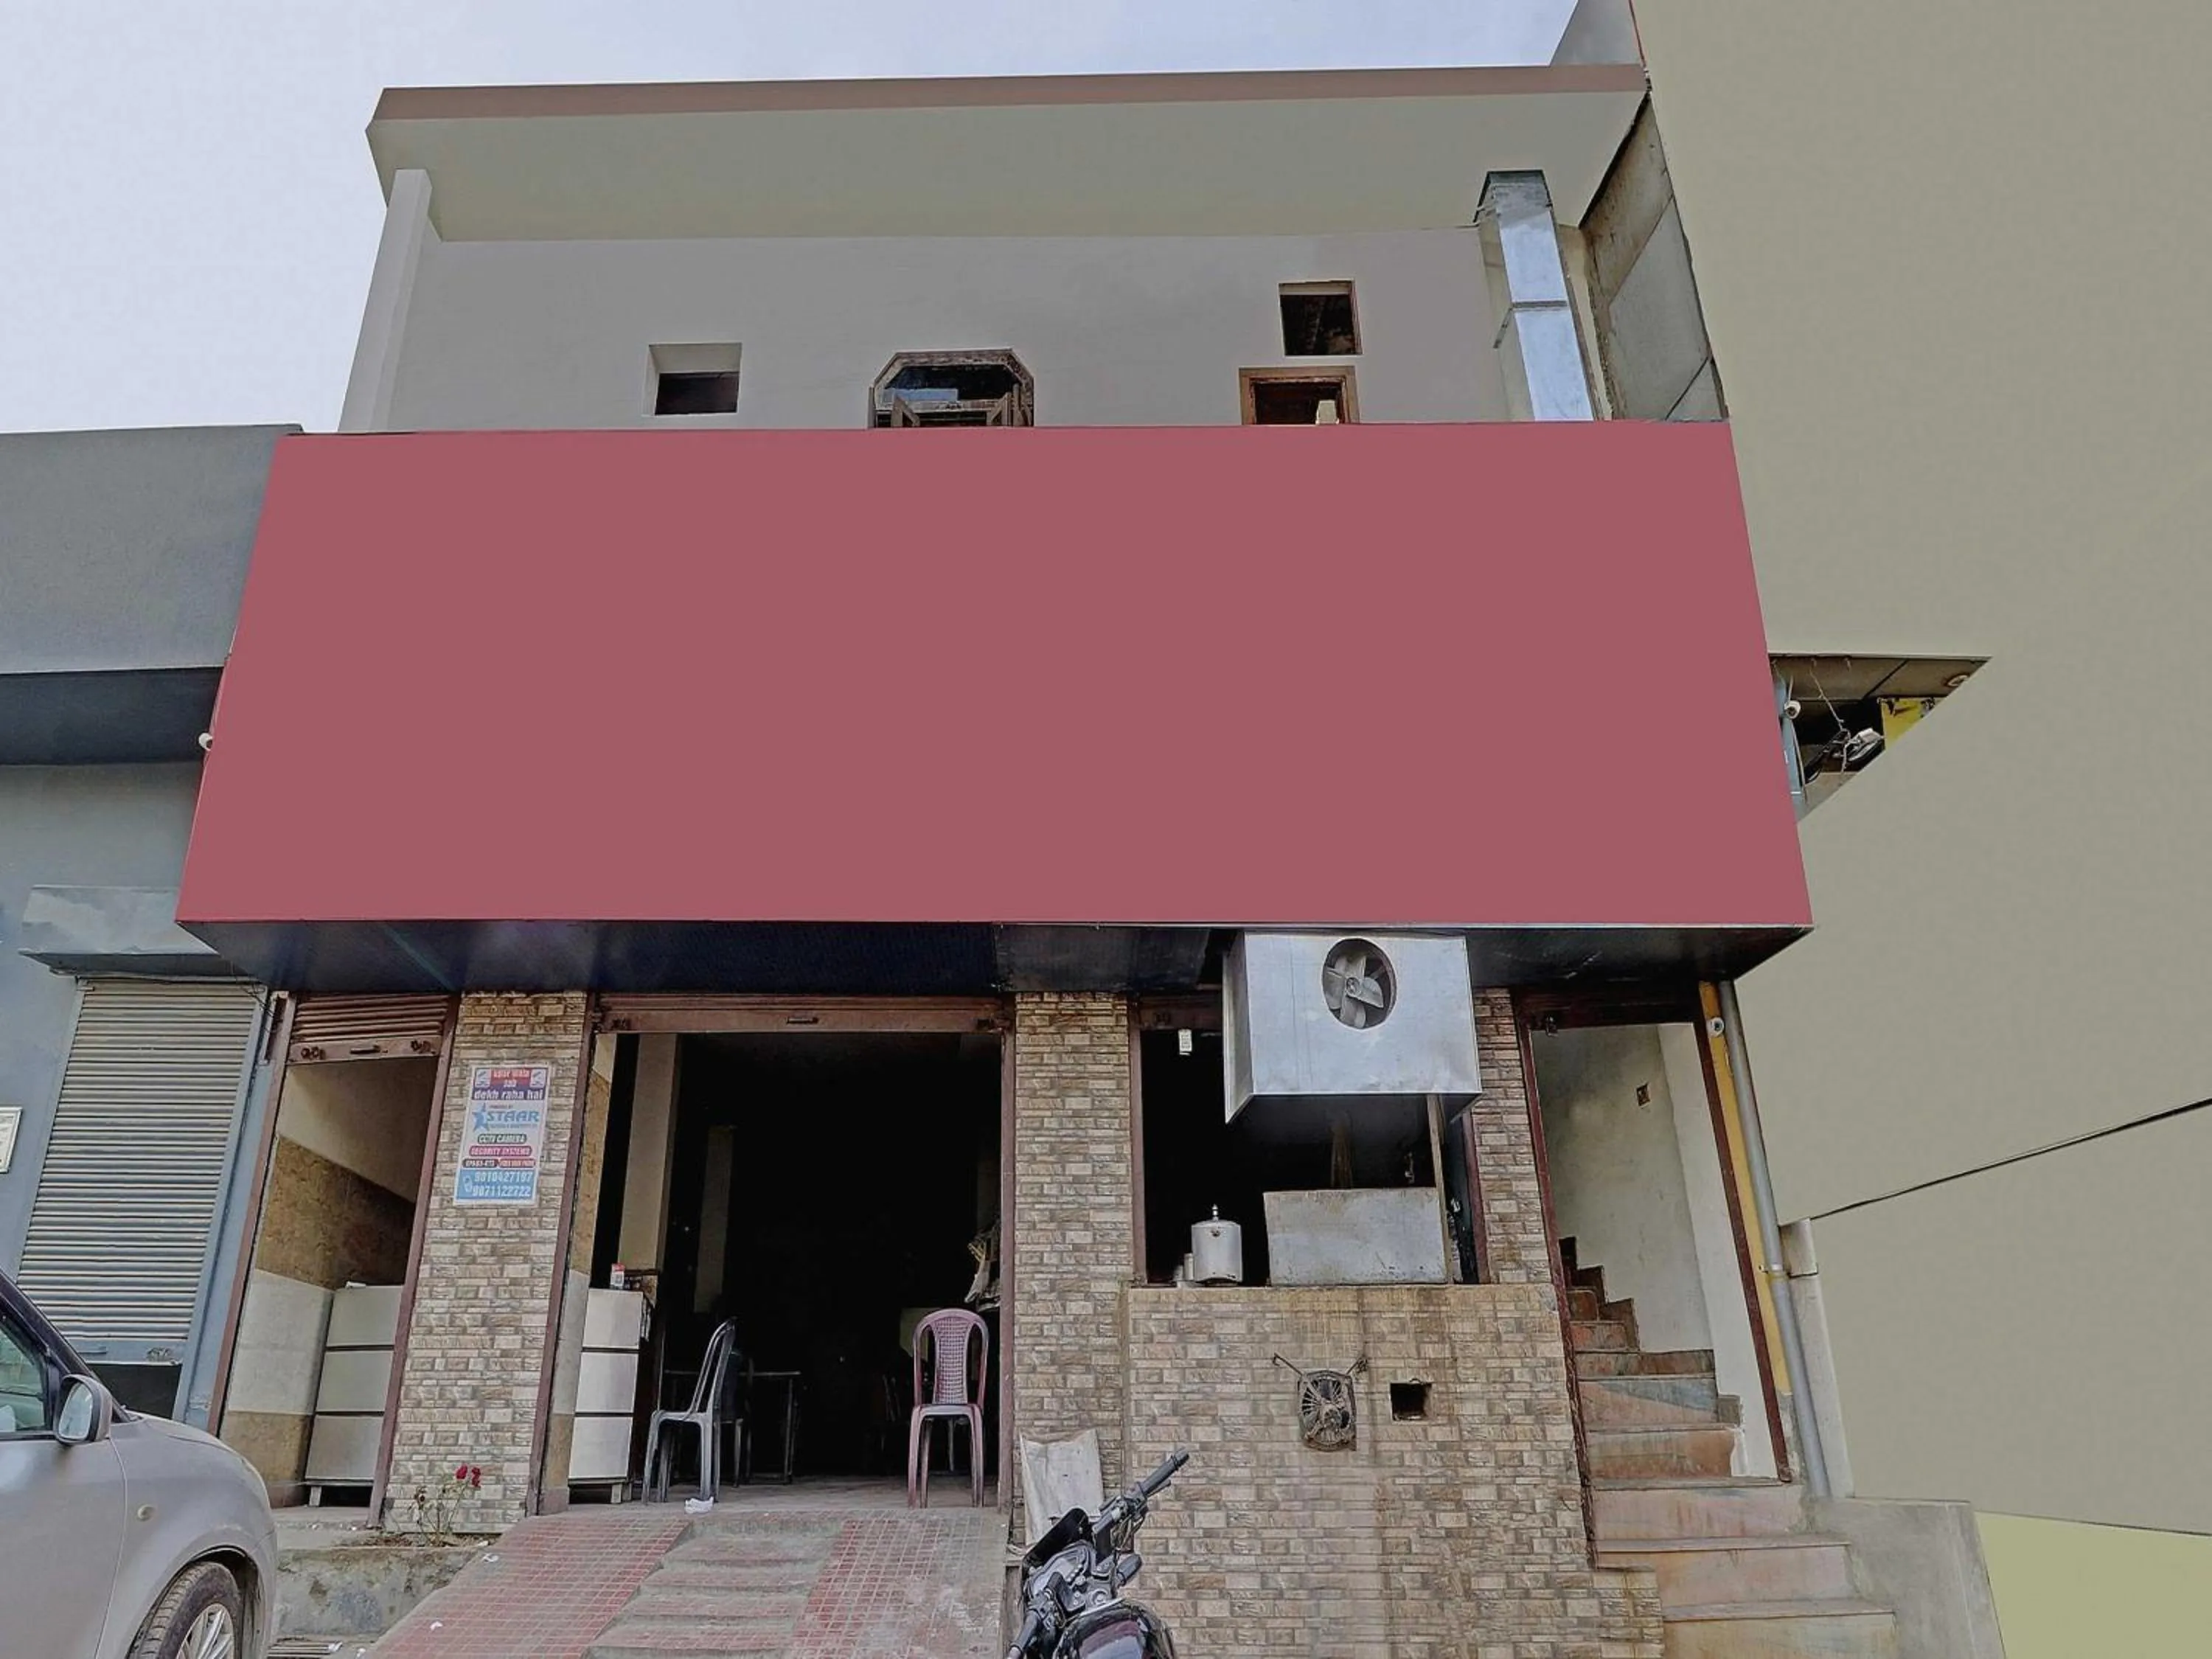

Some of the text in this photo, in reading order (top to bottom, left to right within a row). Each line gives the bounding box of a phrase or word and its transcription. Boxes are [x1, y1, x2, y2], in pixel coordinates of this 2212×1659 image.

[474, 1089, 499, 1099] dekh
[526, 1088, 543, 1099] hai
[487, 1110, 540, 1122] STAAR
